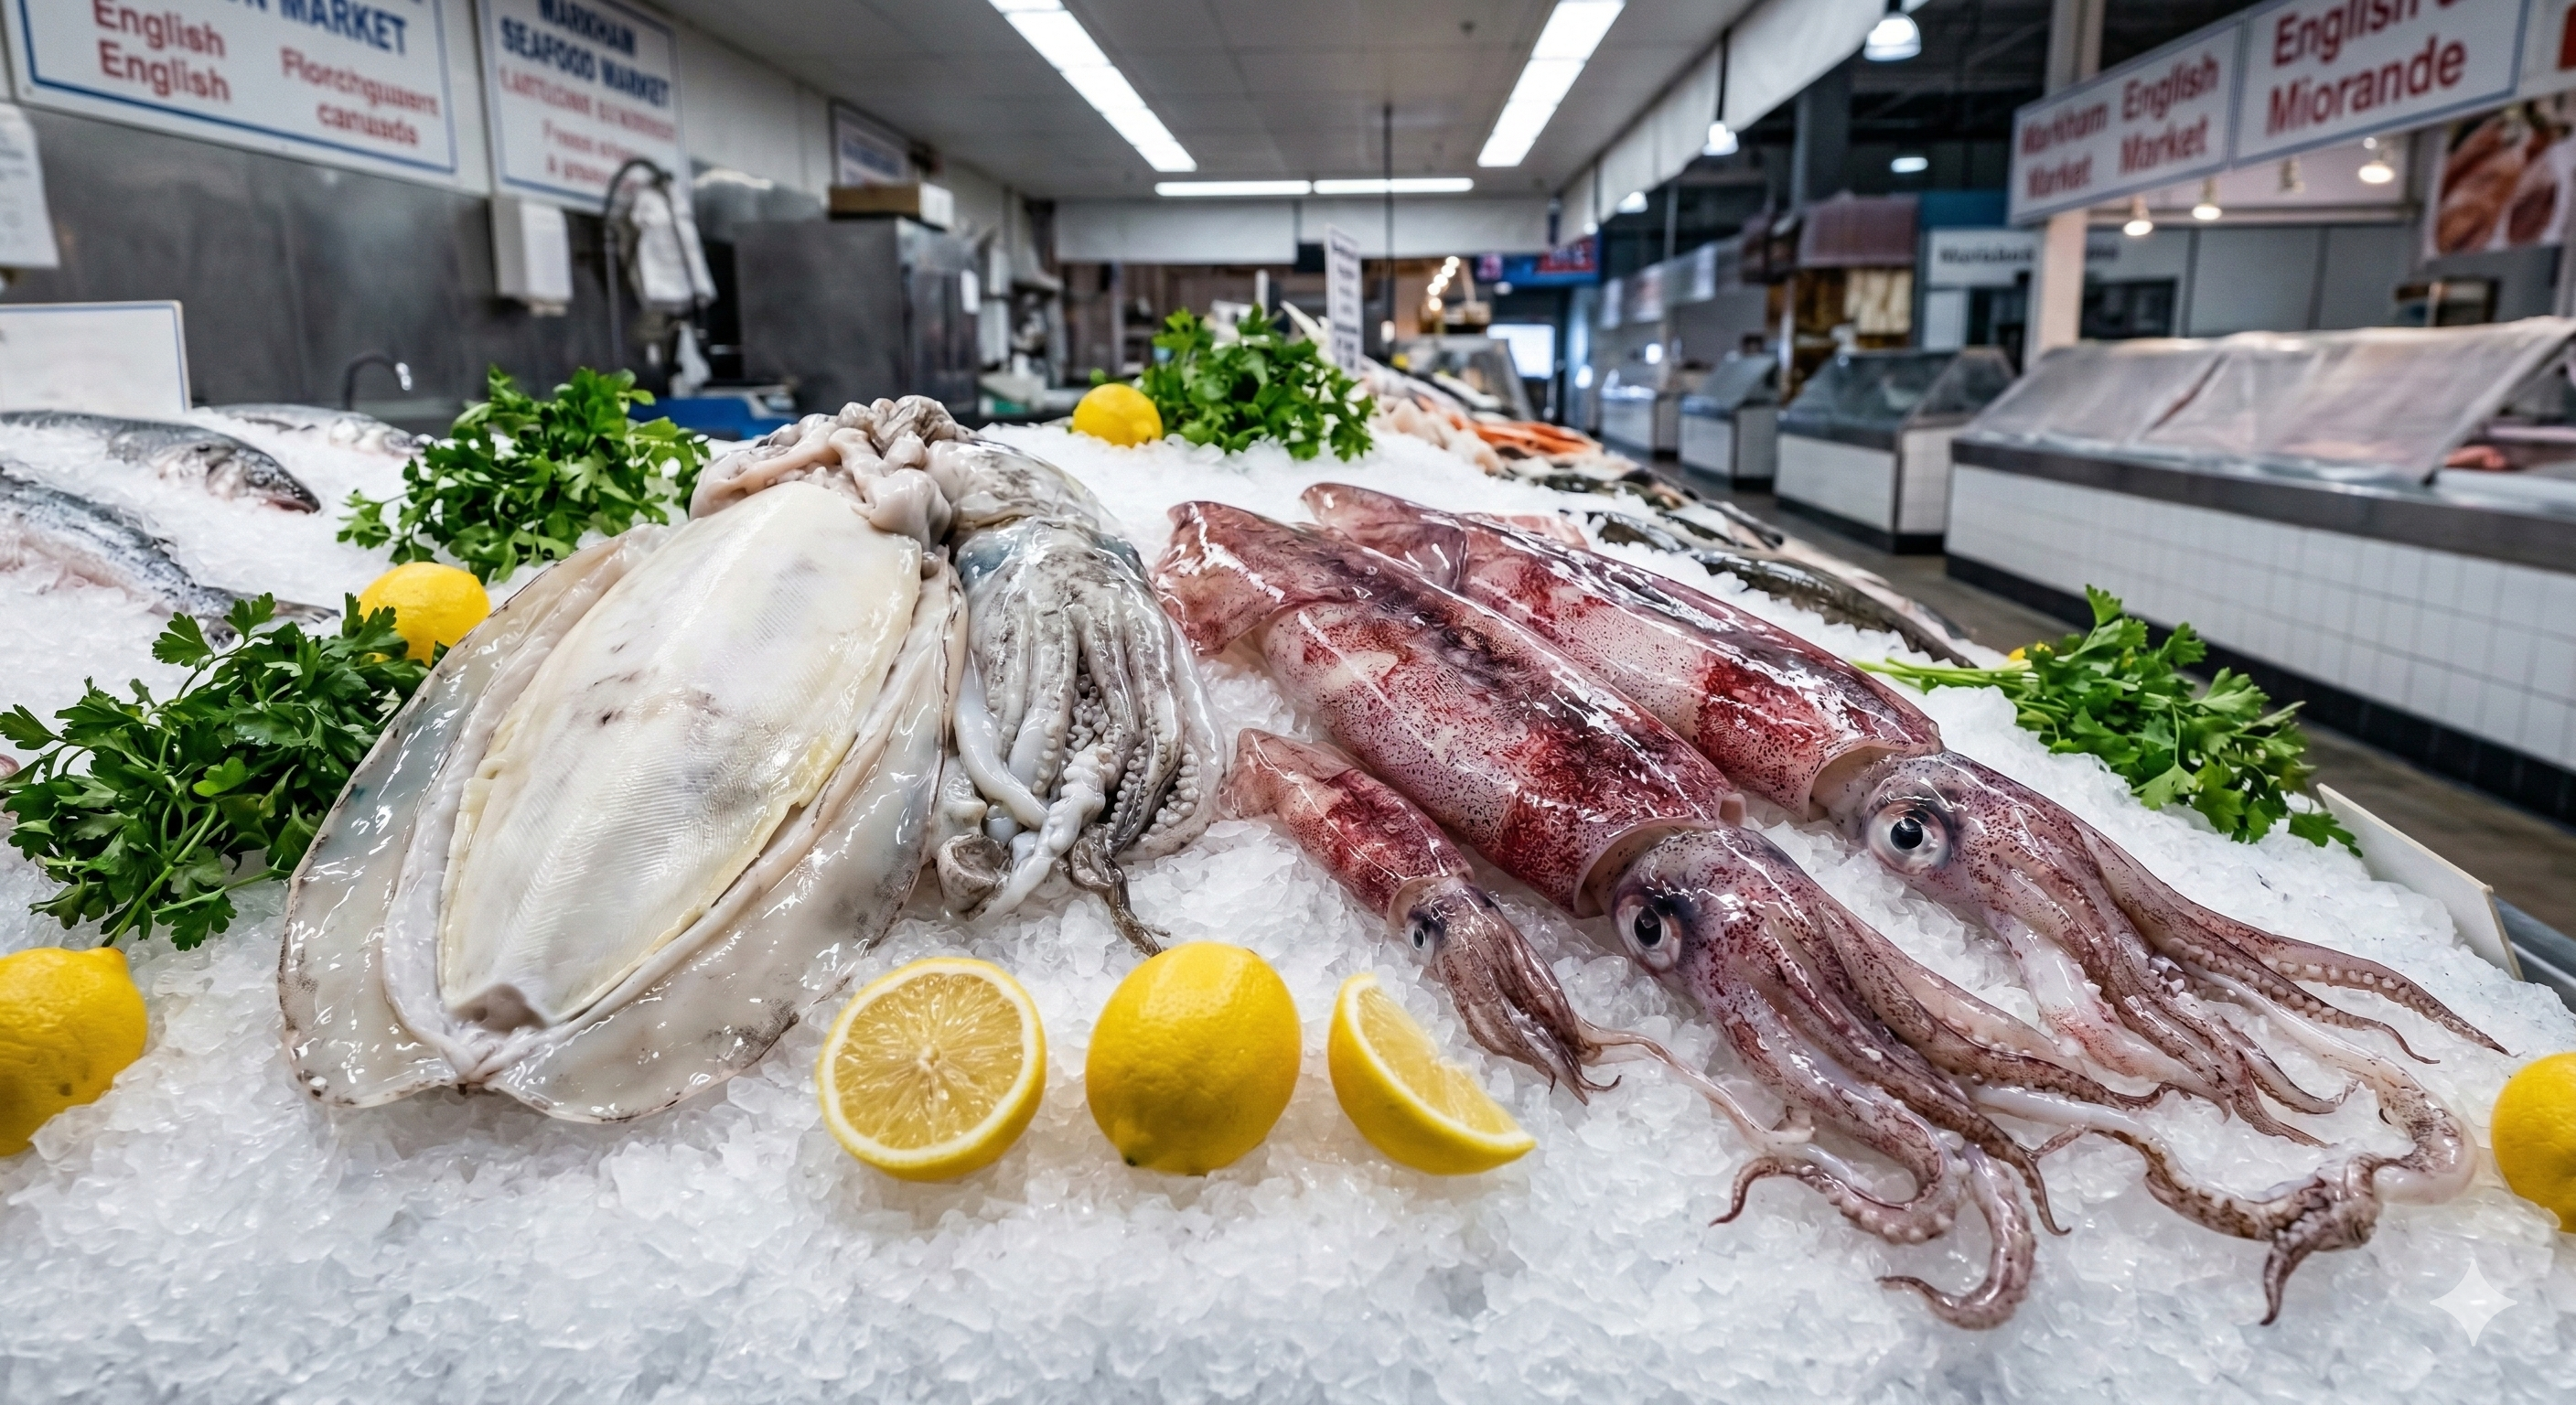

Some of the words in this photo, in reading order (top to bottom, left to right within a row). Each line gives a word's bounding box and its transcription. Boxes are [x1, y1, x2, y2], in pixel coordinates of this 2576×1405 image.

[93, 0, 226, 59] English
[500, 16, 596, 82] SEAFOOD
[98, 38, 231, 102] English
[2121, 50, 2220, 123] English
[2266, 33, 2466, 137] Miorande
[2119, 113, 2209, 177] Market
